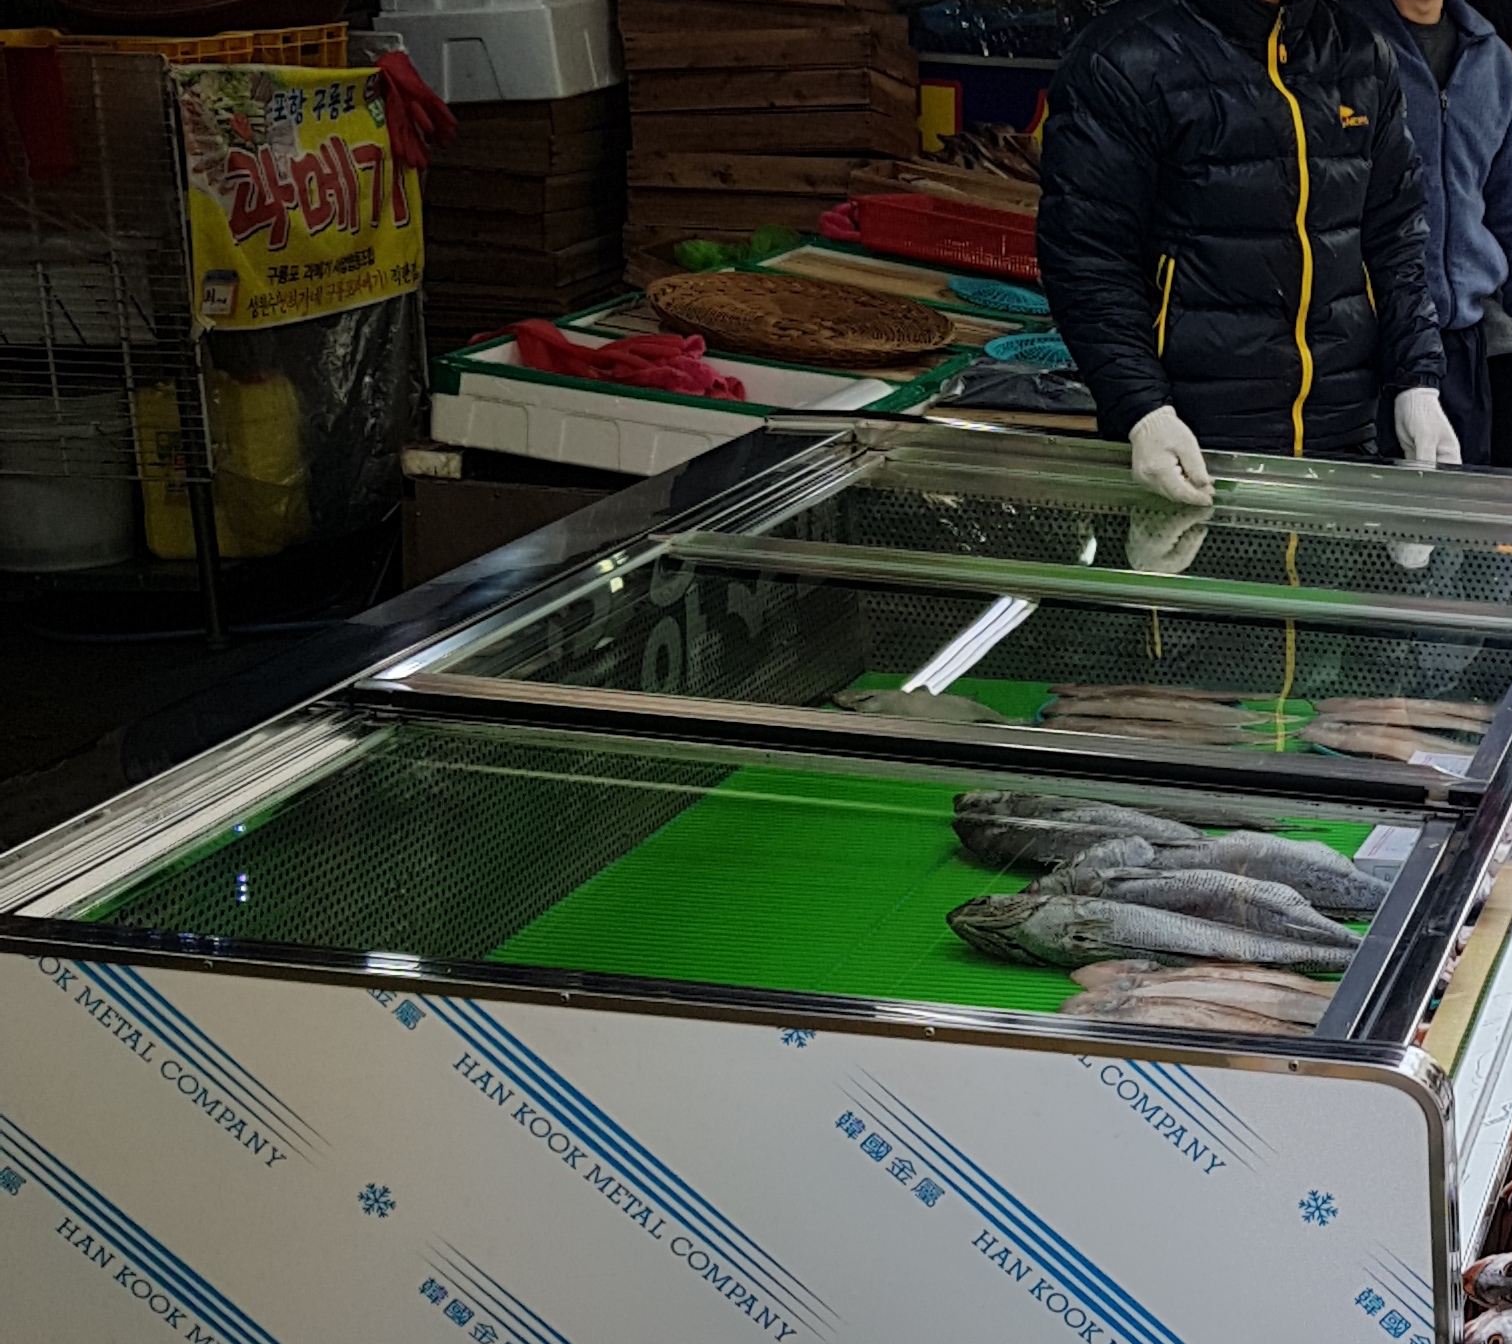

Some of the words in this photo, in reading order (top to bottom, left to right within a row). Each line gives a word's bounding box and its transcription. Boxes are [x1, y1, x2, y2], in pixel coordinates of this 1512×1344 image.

[274, 87, 307, 123] 포항
[312, 83, 355, 120] 구룡포
[226, 135, 409, 251] 과메기
[74, 986, 155, 1062] METAL
[160, 1060, 285, 1166] COMPANY
[1100, 1064, 1224, 1173] COMPANY
[452, 1052, 514, 1105] HAN
[510, 1102, 587, 1169] KOOK
[583, 1163, 665, 1238] METAL
[670, 1236, 796, 1340] COMPANY
[56, 1217, 114, 1267] HAN
[112, 1265, 186, 1329] KOOK
[971, 1229, 1031, 1281] HAN
[1028, 1277, 1103, 1343] KOOK
